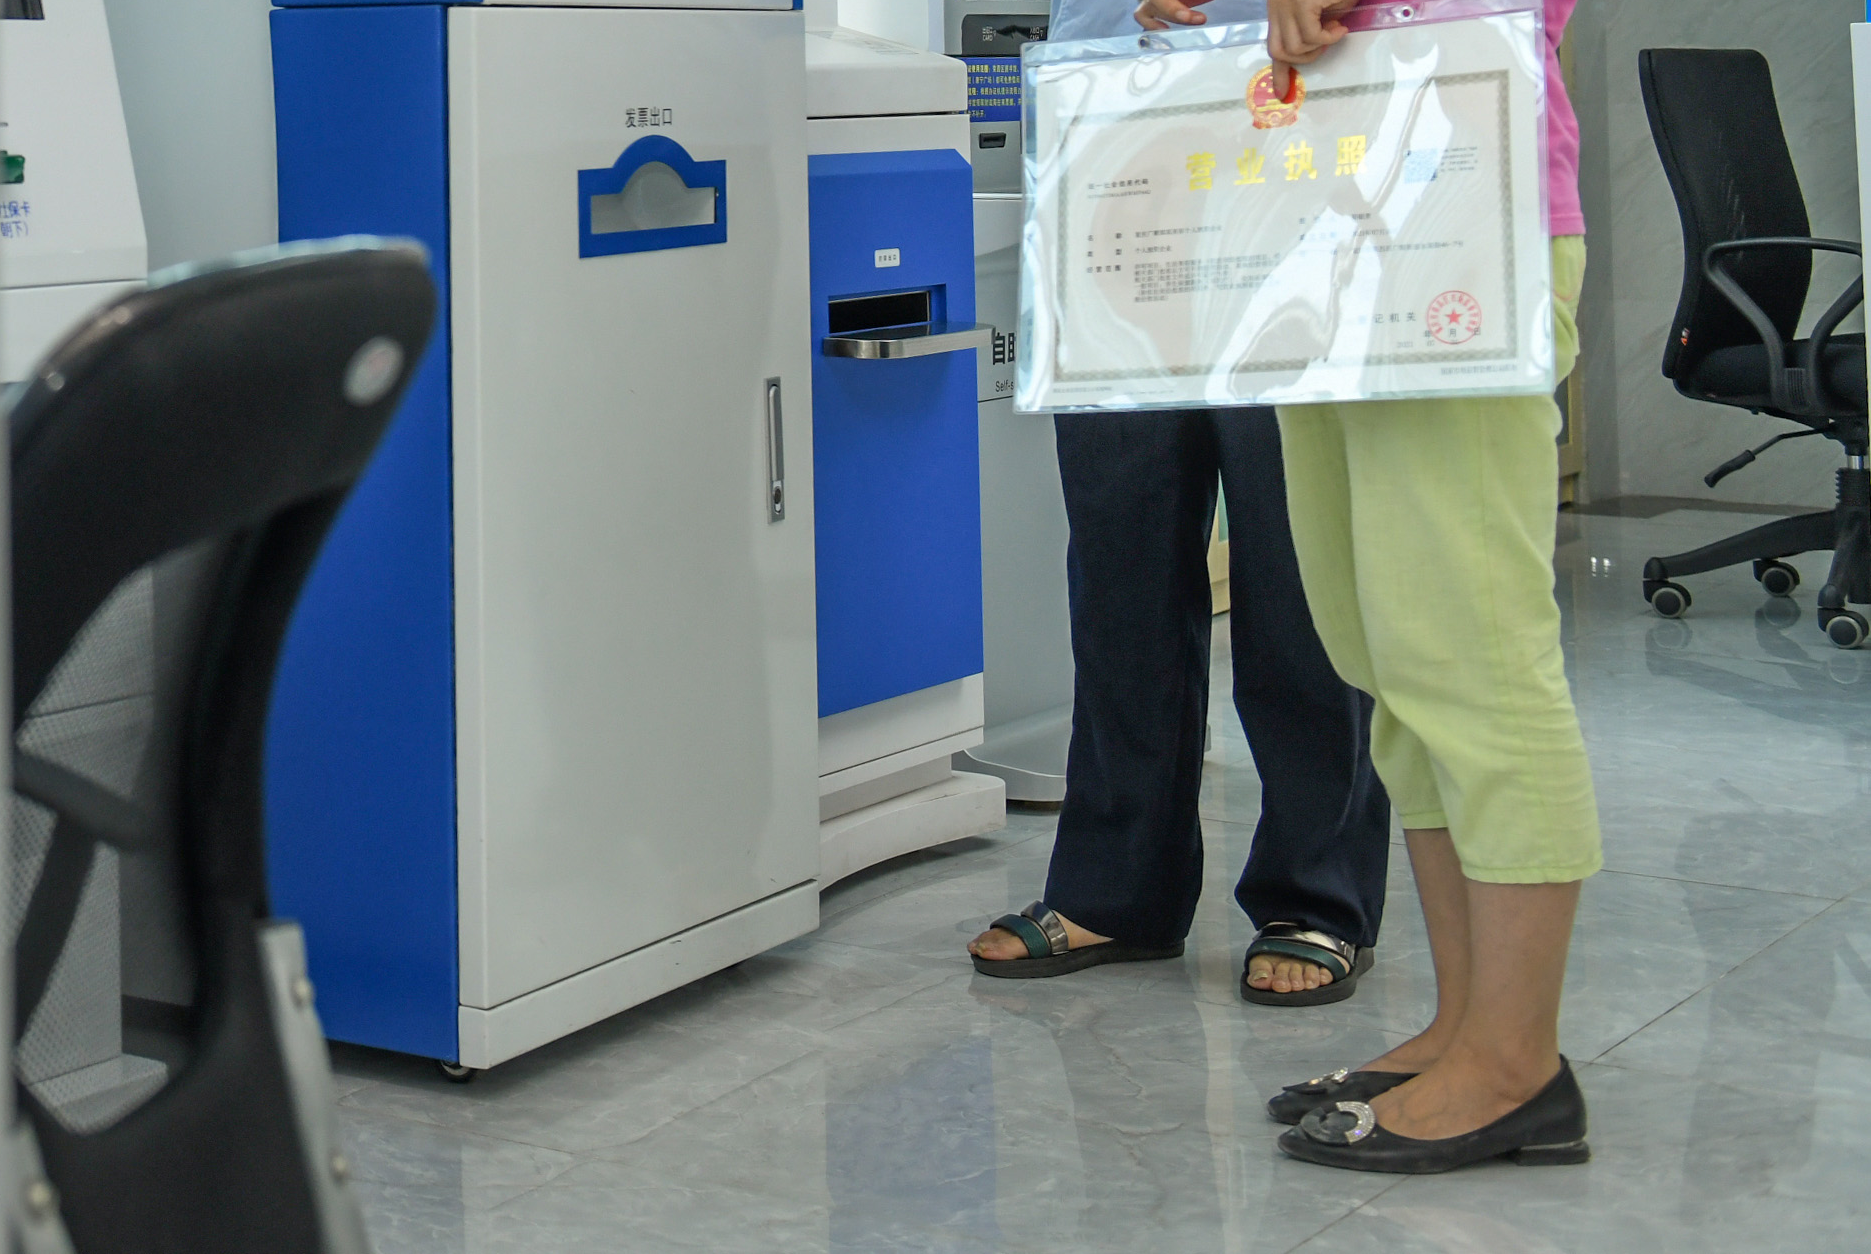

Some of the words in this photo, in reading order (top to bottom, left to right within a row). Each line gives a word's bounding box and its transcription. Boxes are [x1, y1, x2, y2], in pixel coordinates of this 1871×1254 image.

[625, 106, 672, 128] 发票出口
[1186, 134, 1368, 191] 营业执照
